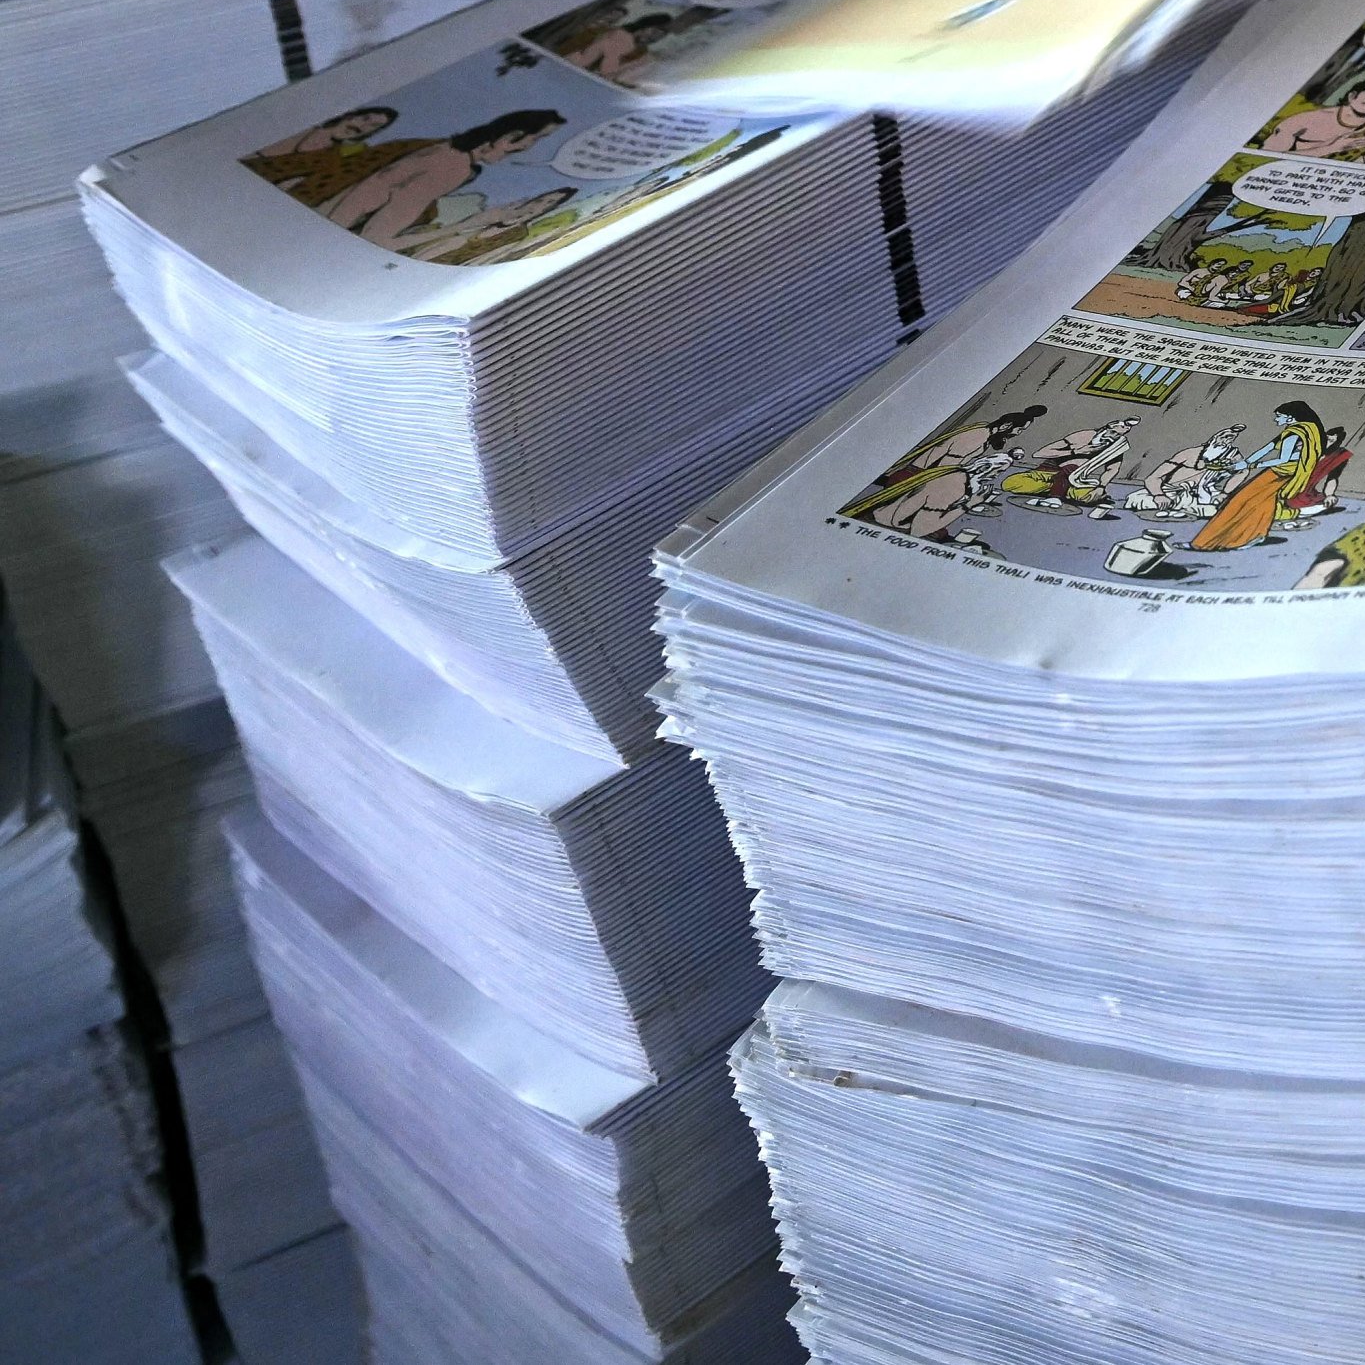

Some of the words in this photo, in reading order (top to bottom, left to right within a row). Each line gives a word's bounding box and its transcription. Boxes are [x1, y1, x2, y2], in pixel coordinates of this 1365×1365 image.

[1241, 184, 1271, 192] AWAY
[1274, 188, 1305, 196] GIFTS
[1246, 176, 1288, 185] EARNED
[1316, 177, 1344, 185] WITH
[1096, 335, 1128, 346] THEM
[1132, 342, 1169, 353] FROM
[1172, 349, 1194, 358] THE
[1195, 354, 1240, 365] COPPER
[1243, 360, 1277, 369] THALI
[1279, 363, 1311, 372] THAT
[1311, 367, 1352, 376] SURYA
[1098, 327, 1130, 337] WERE
[1134, 334, 1156, 342] THE
[1160, 338, 1197, 349] SAGES
[1201, 345, 1227, 353] WHO
[1231, 349, 1276, 360] VISITED
[1280, 355, 1312, 365] THEM
[1108, 347, 1132, 355] BUT
[1135, 351, 1159, 360] SHE
[1161, 357, 1195, 367] MADE
[1198, 362, 1230, 372] SURE
[1259, 371, 1288, 379] WAS
[1316, 376, 1349, 385] LAST
[856, 527, 881, 538] THE
[884, 535, 919, 549] FOOD
[921, 546, 956, 560] FROM
[962, 557, 991, 569] THIS
[996, 565, 1030, 578] THALI
[1034, 575, 1064, 585] WAS
[1066, 580, 1165, 601] INEXHAUSTIBLE
[1165, 594, 1183, 602] AT
[1186, 596, 1219, 604] EACH
[1137, 603, 1161, 612] 728
